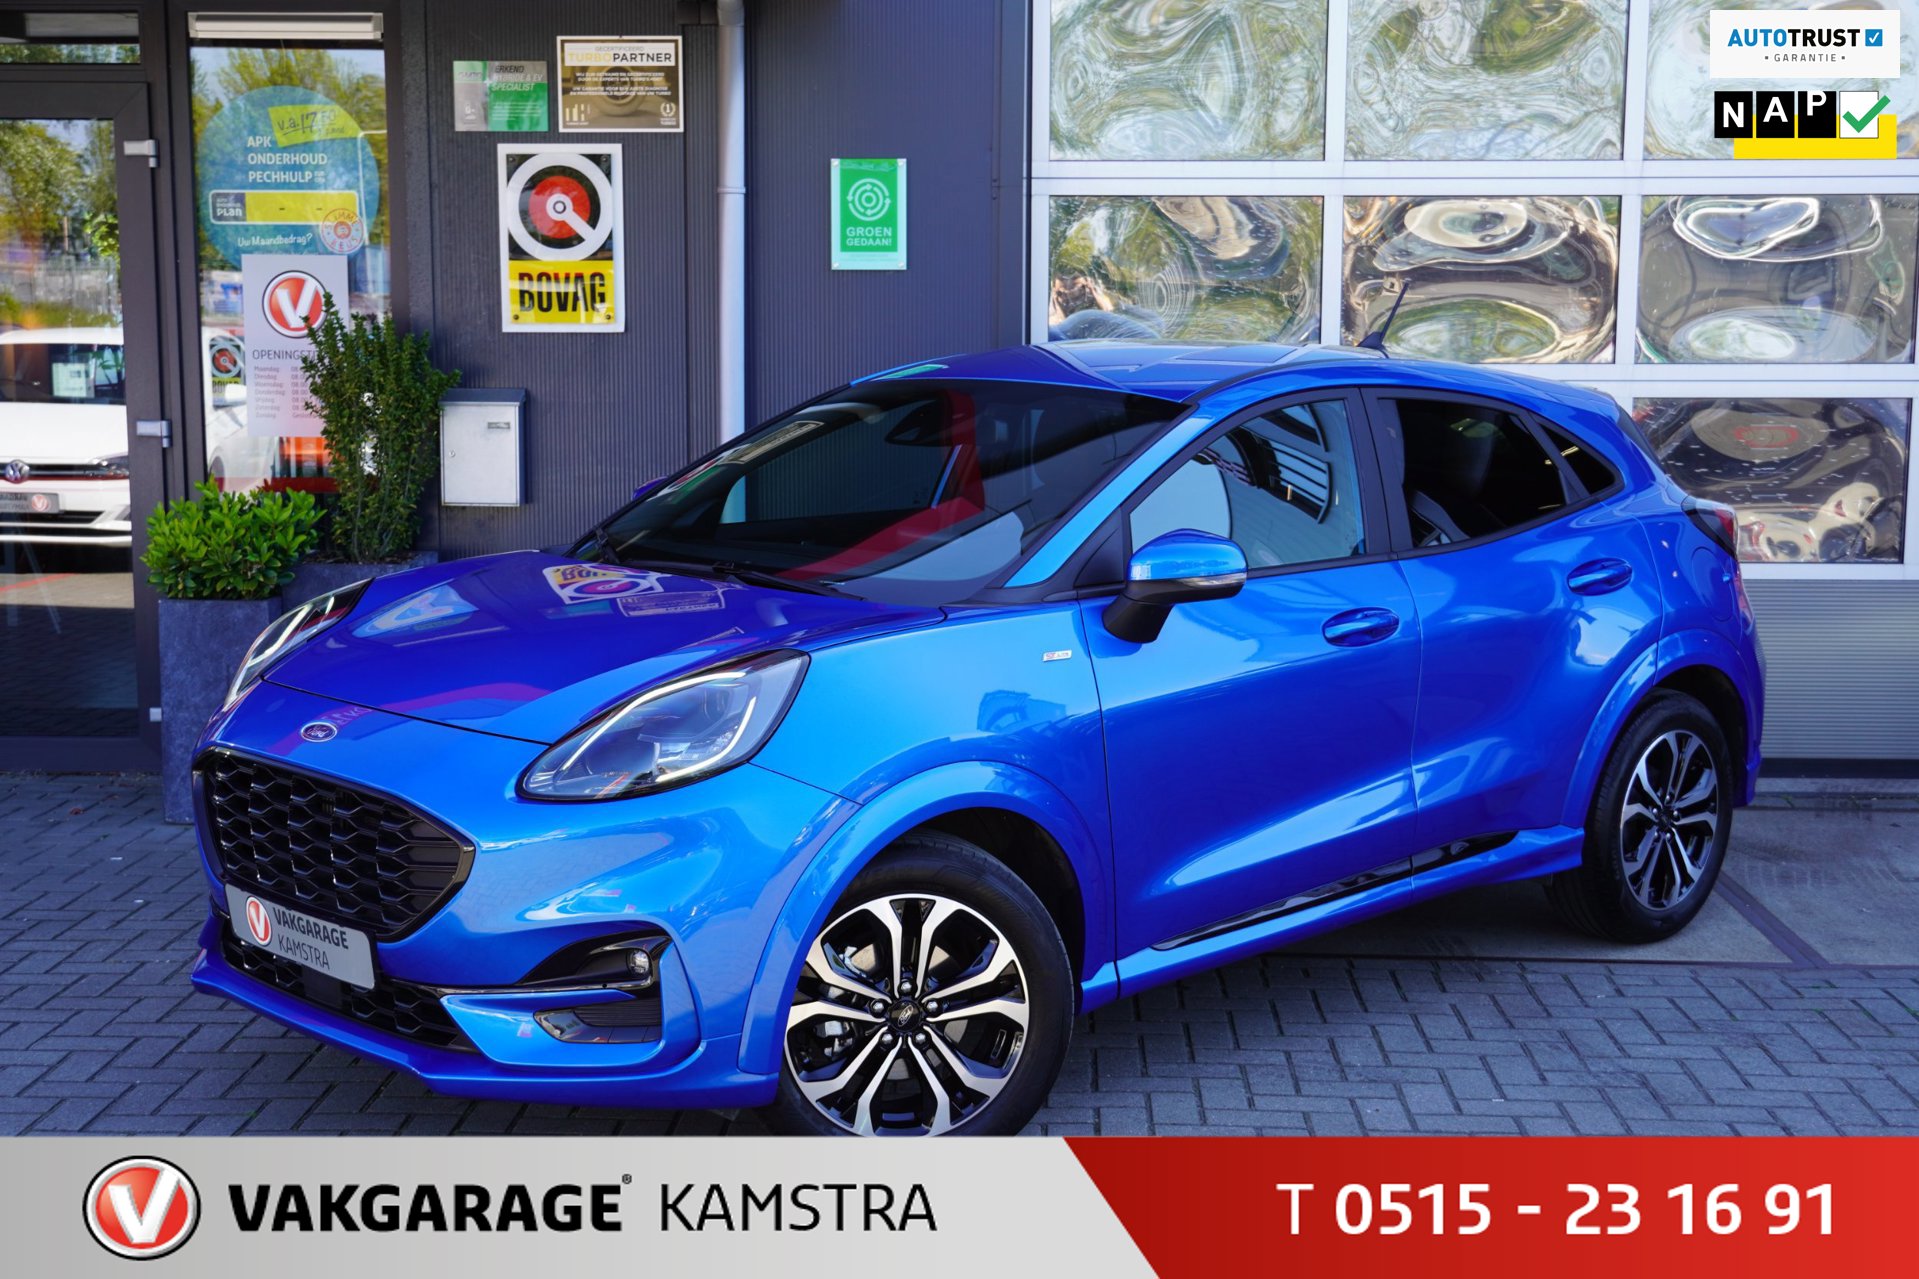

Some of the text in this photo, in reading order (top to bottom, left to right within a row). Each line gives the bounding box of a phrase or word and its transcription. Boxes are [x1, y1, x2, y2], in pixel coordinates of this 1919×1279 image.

[494, 64, 525, 73] ERKEND
[491, 82, 535, 92] SPECIALIST
[247, 136, 272, 147] APK
[247, 153, 328, 165] ONDERHOUD
[248, 171, 313, 183] PECHHULP
[846, 226, 892, 237] GROEN
[251, 232, 313, 247] Maandbedrag?
[846, 238, 892, 246] GEDAAN!
[518, 271, 607, 313] BOVAG
[273, 907, 349, 950] VAKGARAGE
[278, 933, 331, 970] KAMSTRA
